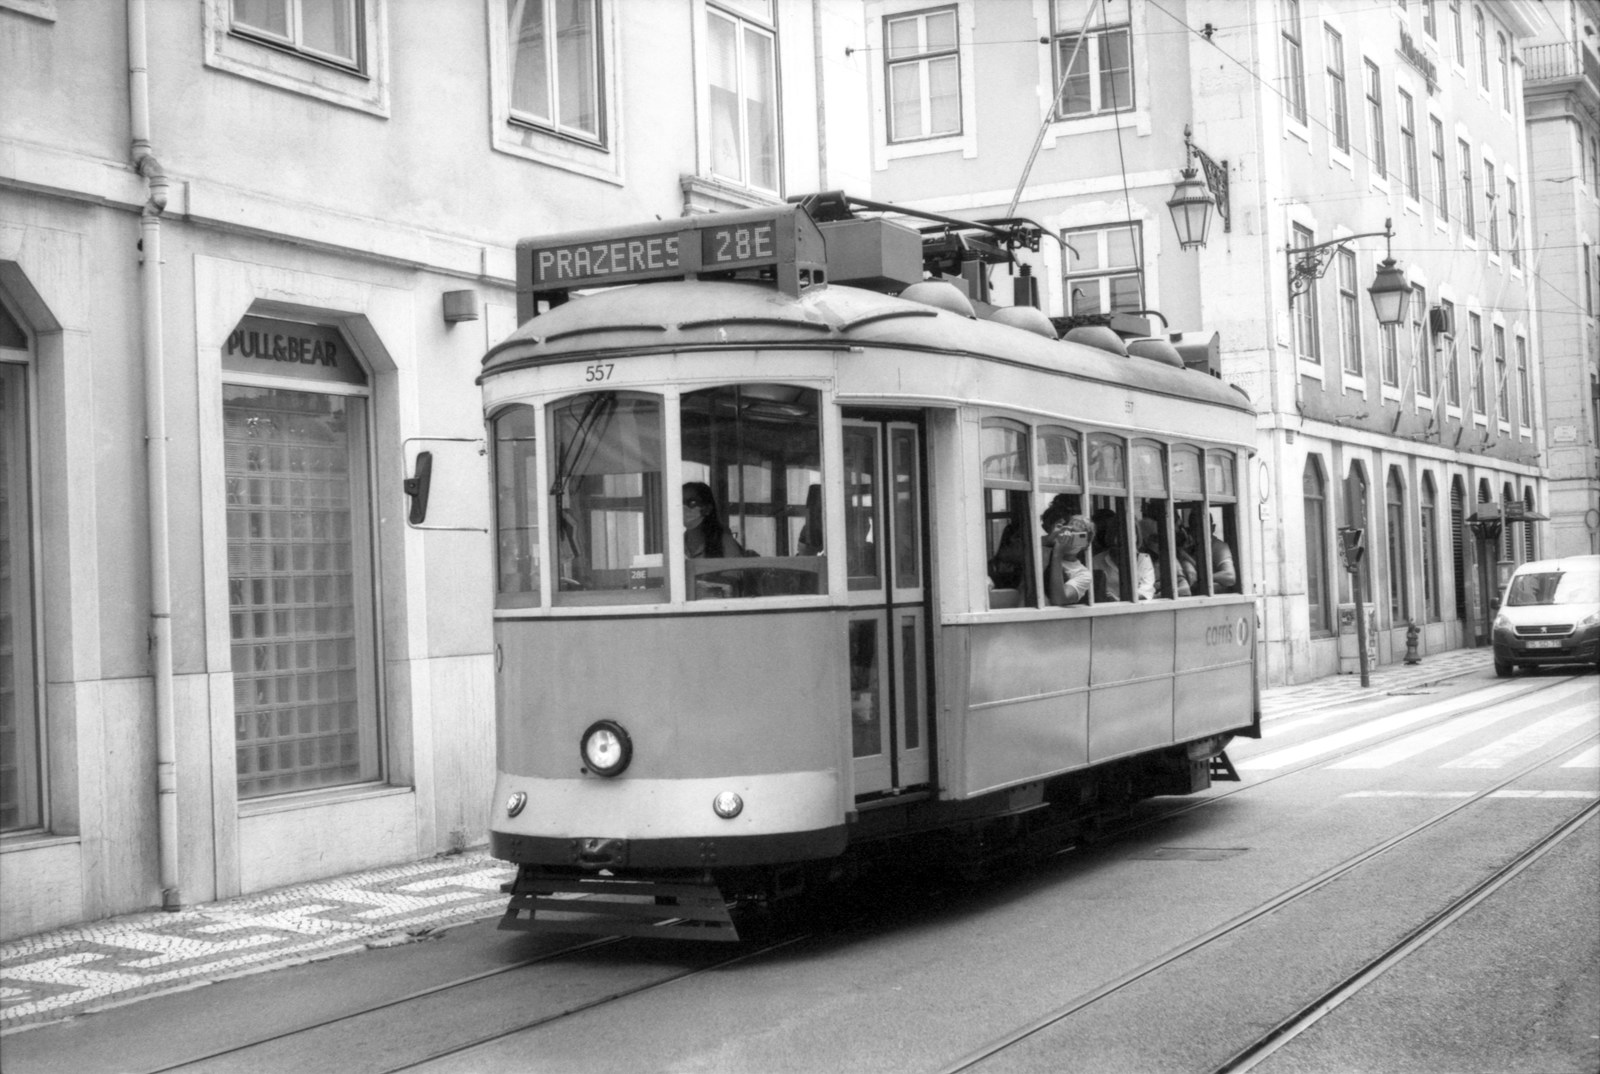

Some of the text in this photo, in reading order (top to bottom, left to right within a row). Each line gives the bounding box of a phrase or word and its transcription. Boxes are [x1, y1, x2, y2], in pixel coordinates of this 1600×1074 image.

[539, 236, 679, 280] PRAZERES
[715, 226, 773, 262] 28E
[227, 329, 338, 368] PULL&BEAR
[585, 363, 615, 382] 557
